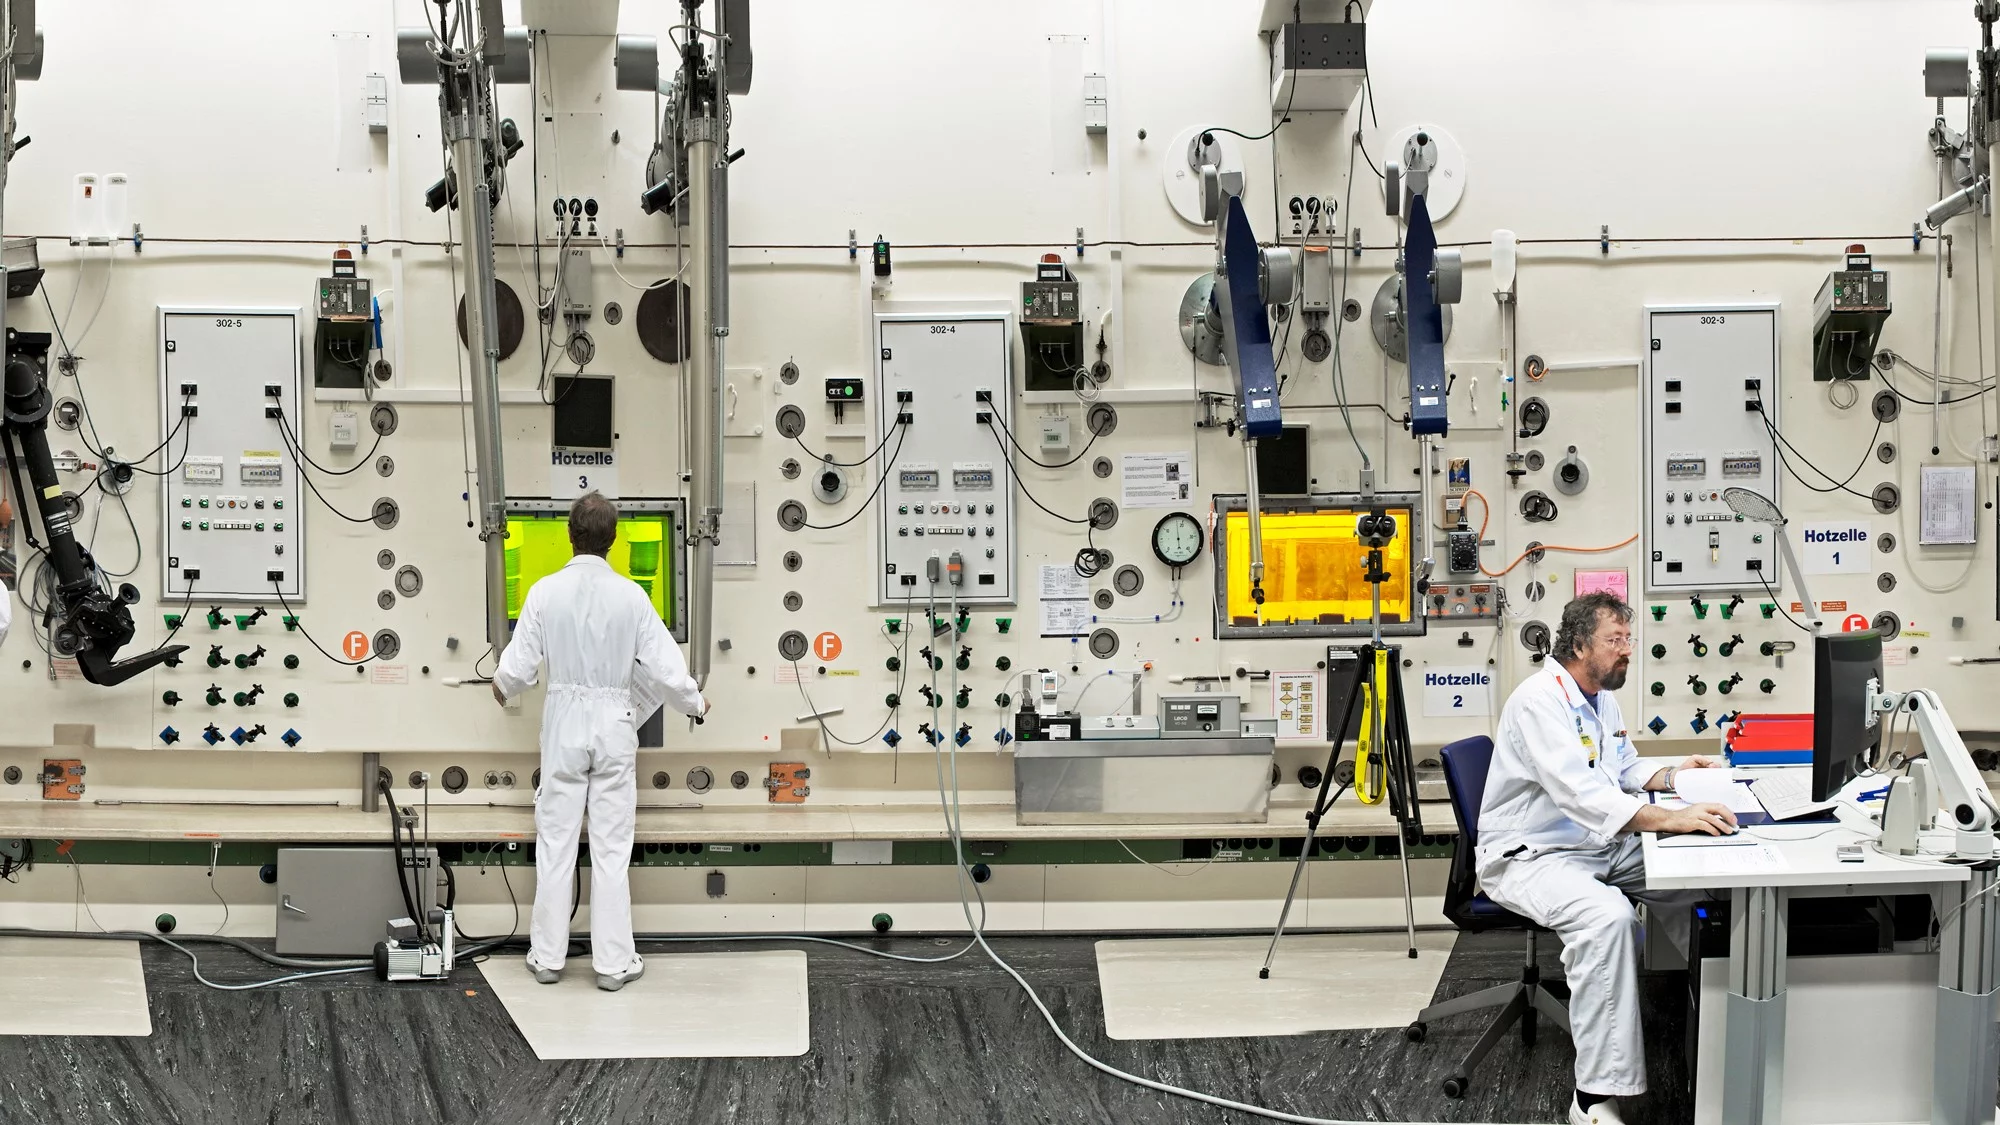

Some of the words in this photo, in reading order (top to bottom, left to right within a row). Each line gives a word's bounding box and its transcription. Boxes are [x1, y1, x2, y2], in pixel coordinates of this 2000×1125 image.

[216, 319, 242, 327] 302-5
[930, 326, 956, 334] 302-4
[552, 452, 613, 465] Hotzelle
[579, 476, 588, 489] 3
[1805, 529, 1867, 542] Hotzelle
[1833, 552, 1839, 564] 1
[350, 634, 362, 656] F
[822, 635, 834, 657] F
[1426, 673, 1490, 685] Hotzelle
[1453, 695, 1462, 707] 2
